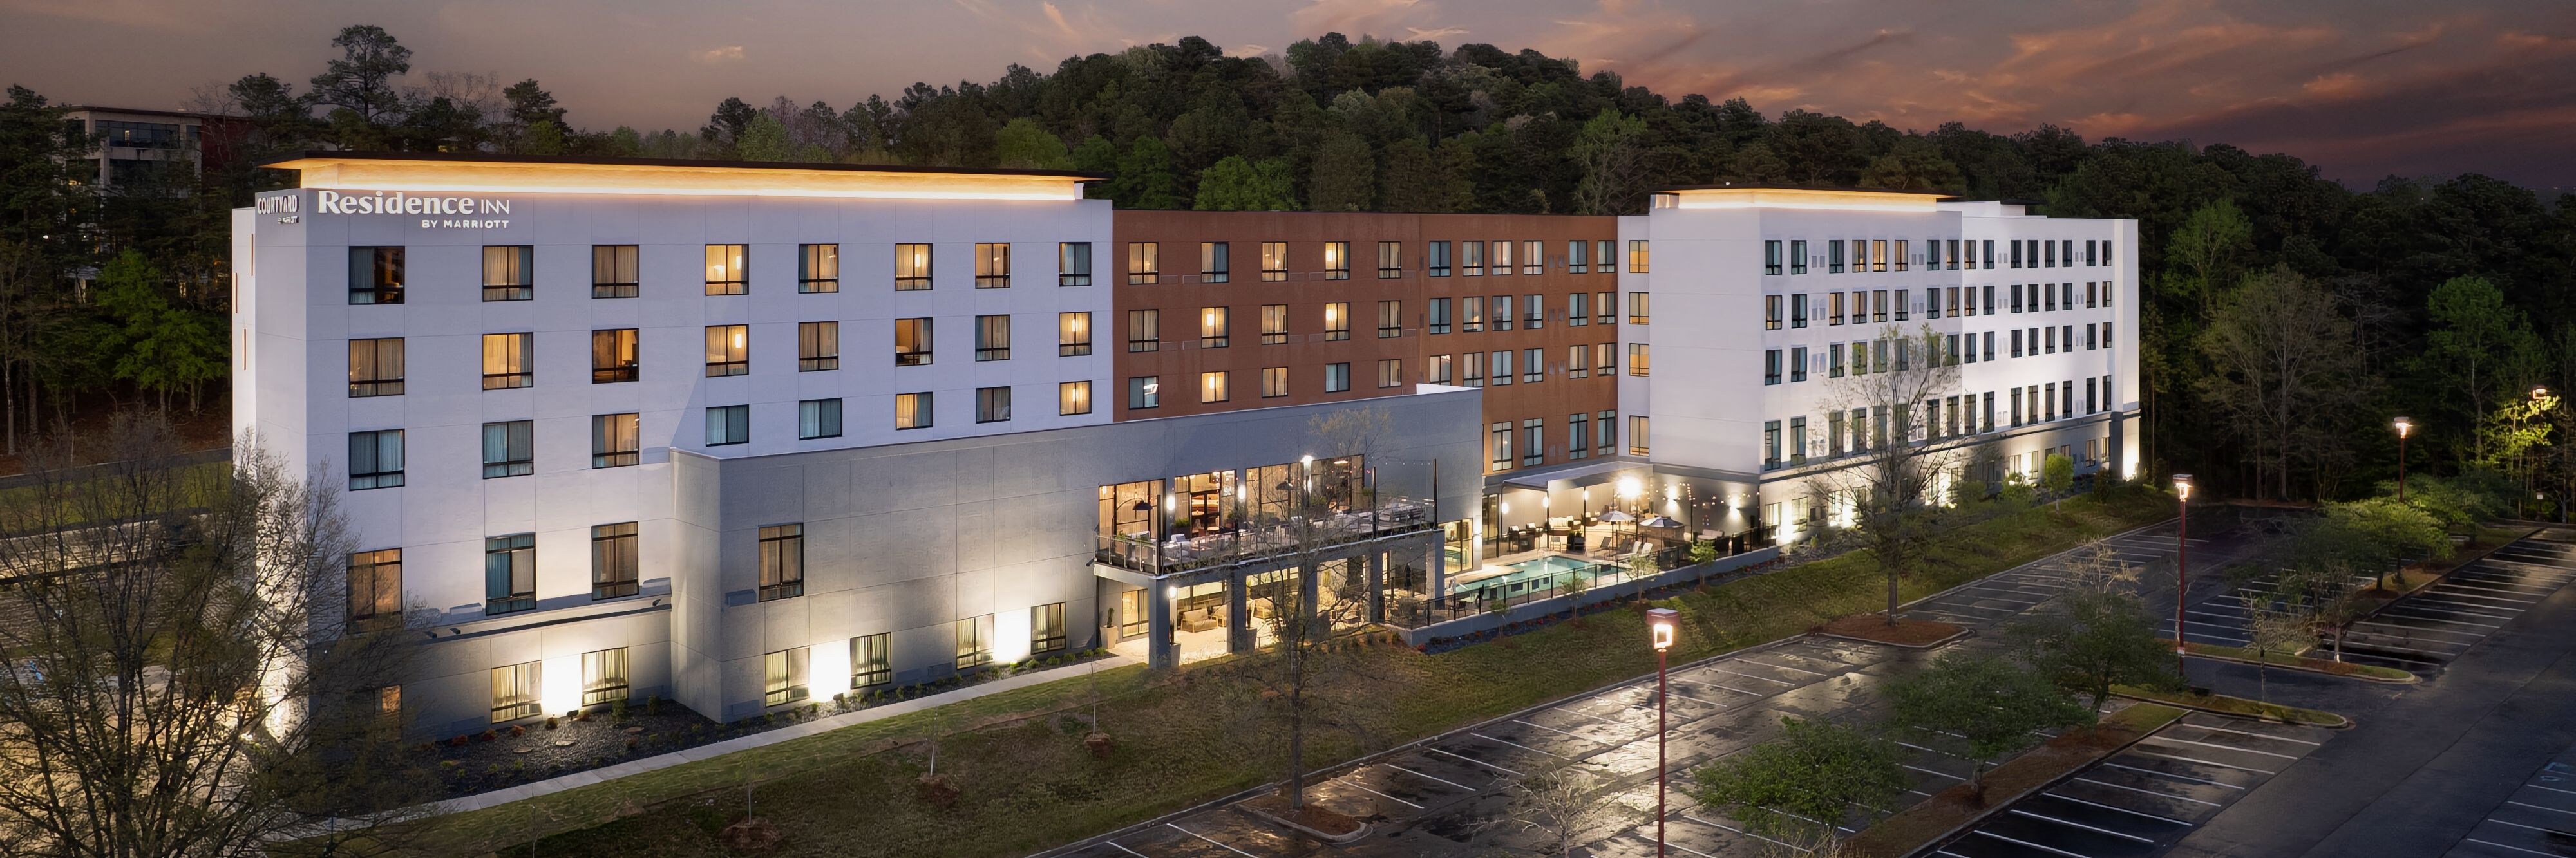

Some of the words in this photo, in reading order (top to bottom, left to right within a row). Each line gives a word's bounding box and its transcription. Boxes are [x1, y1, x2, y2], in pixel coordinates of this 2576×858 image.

[258, 195, 298, 214] COURTYARD
[318, 191, 475, 214] Residence
[480, 199, 509, 214] INN
[422, 219, 438, 228] BY
[443, 219, 509, 228] MARRIOTT
